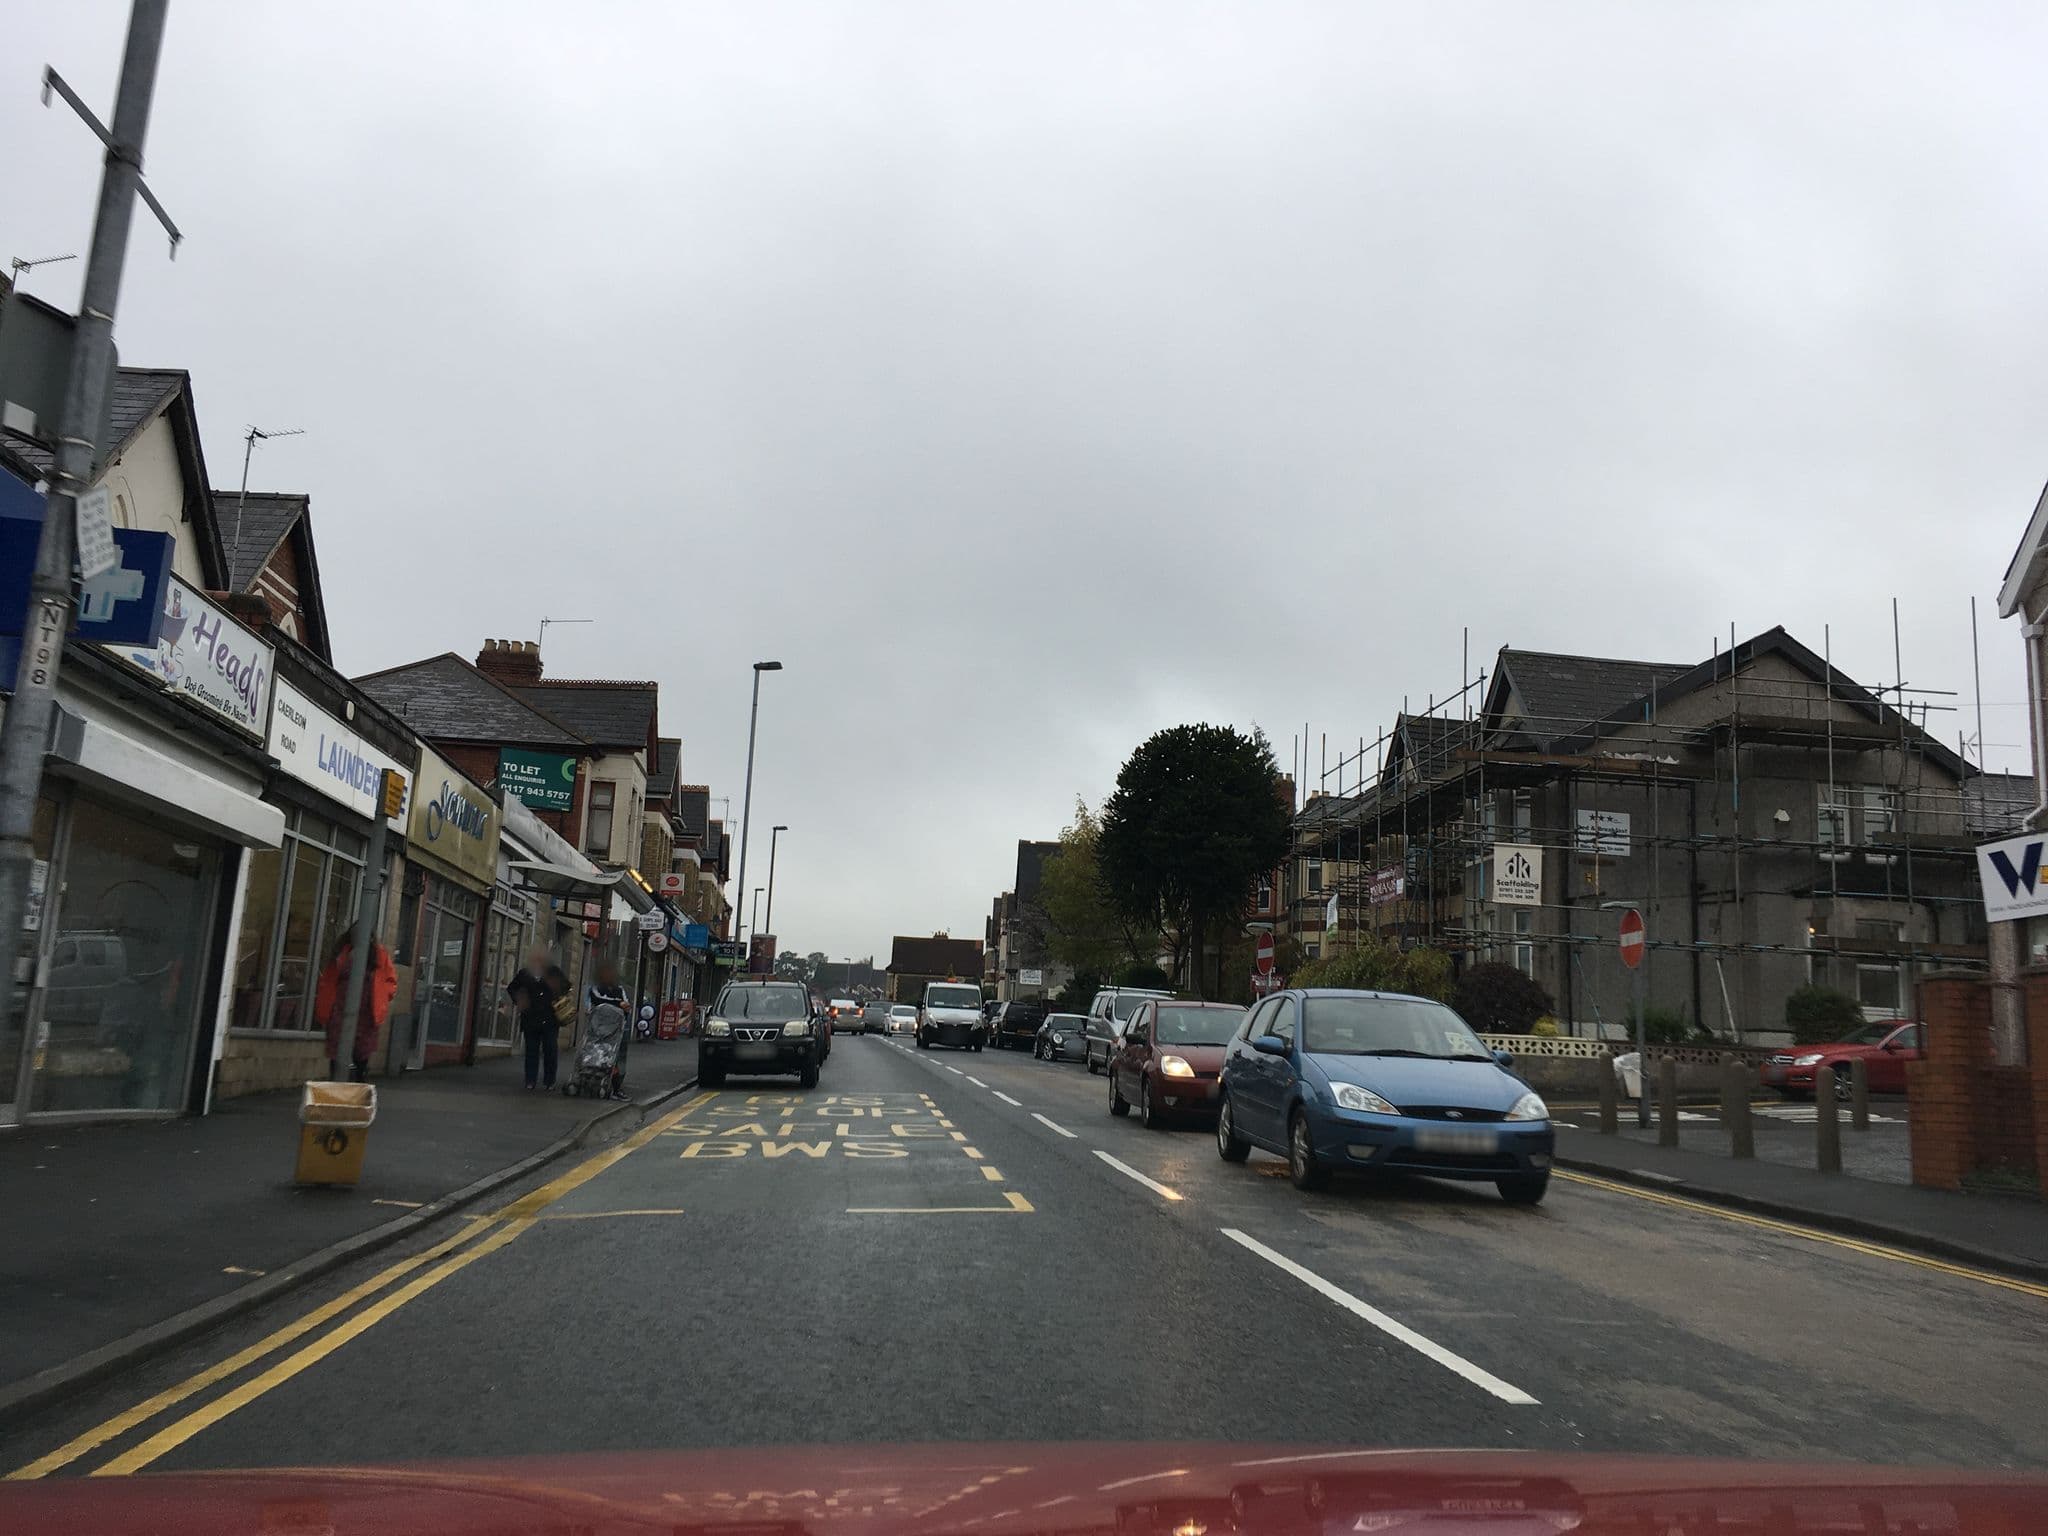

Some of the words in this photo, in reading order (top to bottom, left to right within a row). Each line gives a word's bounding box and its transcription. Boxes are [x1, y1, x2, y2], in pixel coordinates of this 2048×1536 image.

[277, 699, 307, 730] CAERLEON
[280, 734, 297, 754] ROAD
[503, 762, 518, 772] TO
[520, 765, 541, 776] LET
[514, 775, 546, 784] ENQUIRIES
[527, 787, 545, 797] 943
[546, 790, 571, 800] 5757
[1496, 879, 1540, 890] Scaffolding
[745, 1096, 885, 1106] BUS
[707, 1106, 919, 1118] STOP
[661, 1123, 946, 1138] SAFLE
[680, 1141, 910, 1158] BWS
